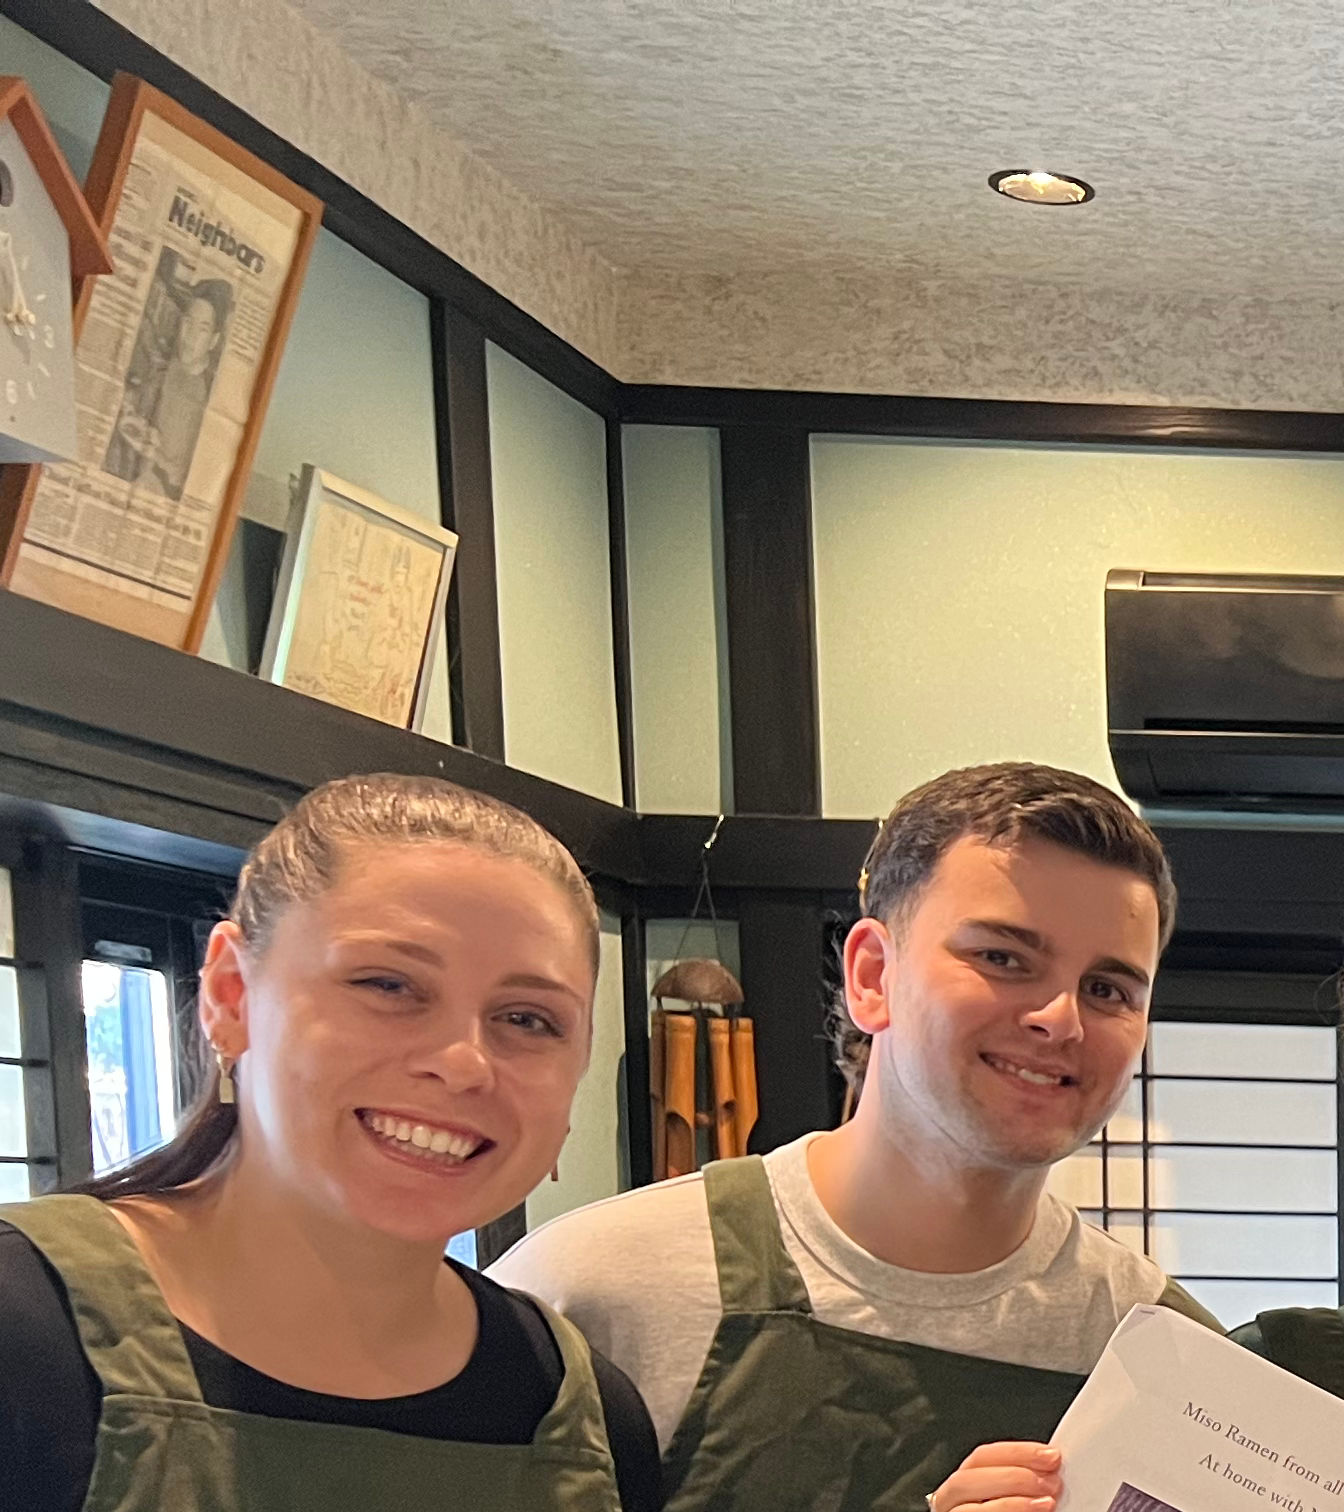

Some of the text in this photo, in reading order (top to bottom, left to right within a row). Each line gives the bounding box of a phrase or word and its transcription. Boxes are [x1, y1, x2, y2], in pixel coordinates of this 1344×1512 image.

[1182, 1401, 1222, 1432] Miso
[1224, 1424, 1280, 1463] Ramen
[1282, 1455, 1321, 1484] from
[1323, 1479, 1344, 1496] all
[1198, 1453, 1219, 1473] At
[1222, 1463, 1267, 1497] home
